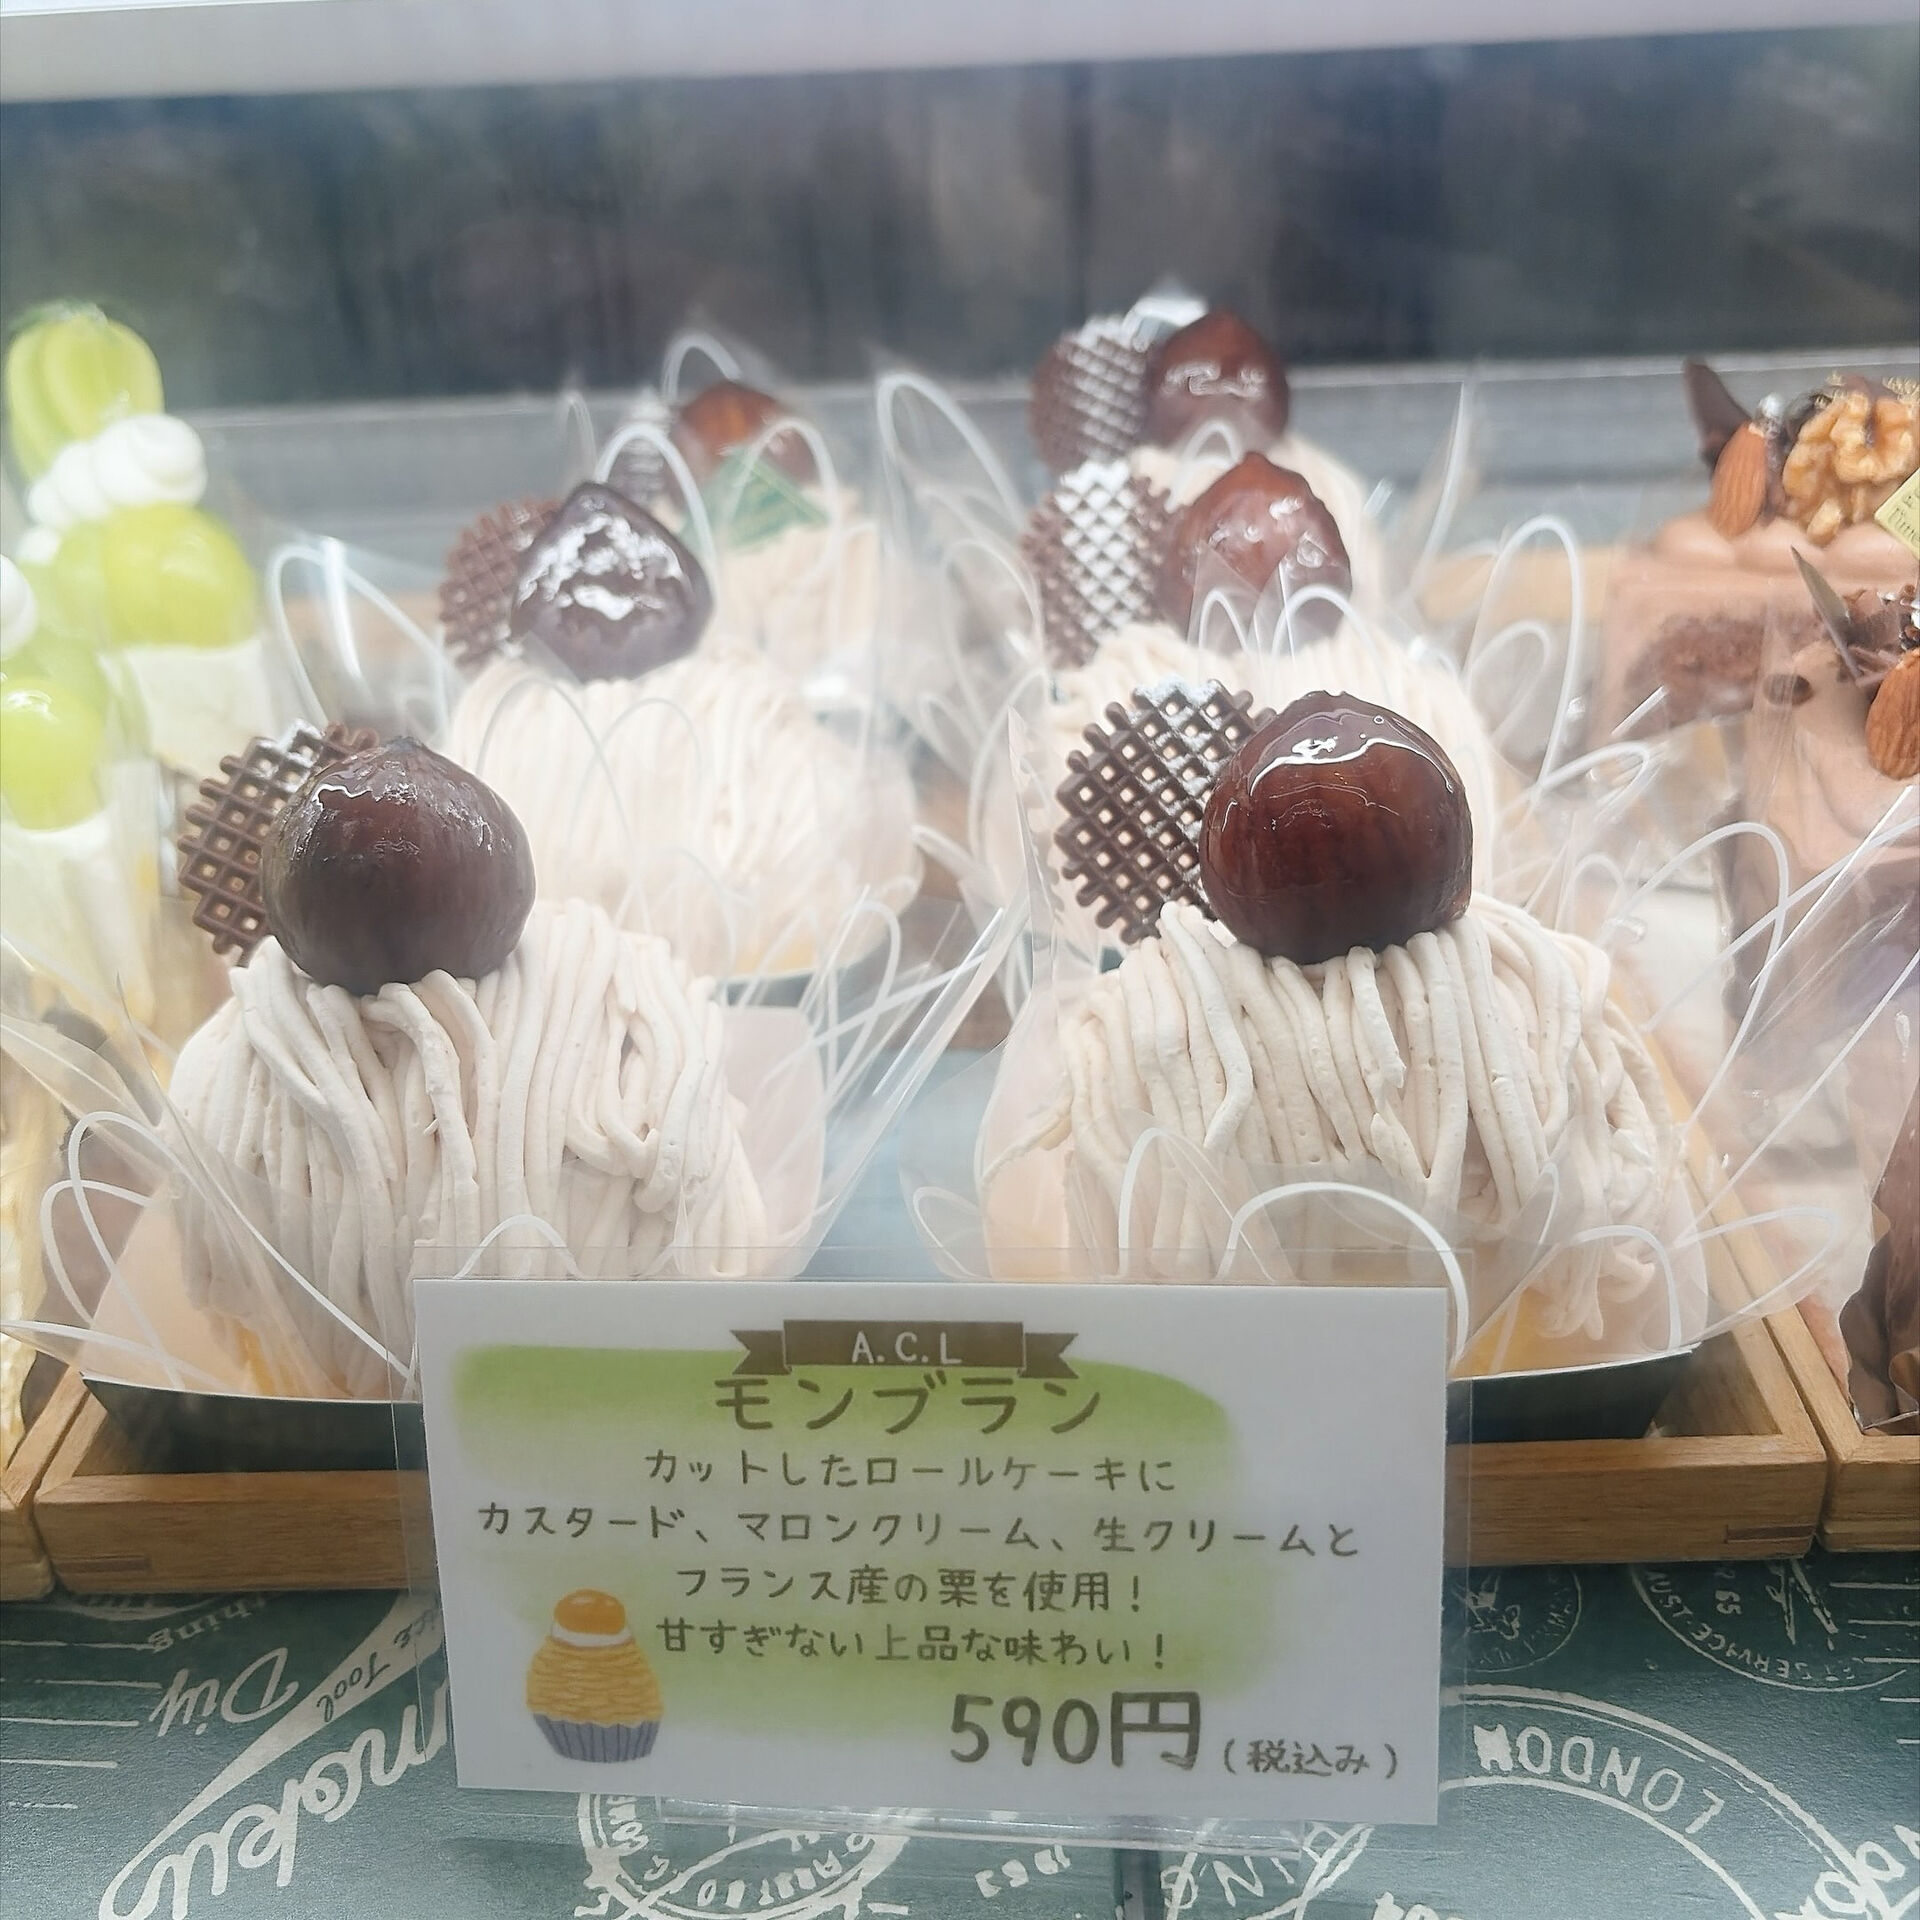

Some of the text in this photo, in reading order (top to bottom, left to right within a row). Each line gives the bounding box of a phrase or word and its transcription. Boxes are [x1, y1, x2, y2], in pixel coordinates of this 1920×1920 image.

[852, 1331, 962, 1365] A.C.L
[715, 1370, 1100, 1434] モンブラン
[645, 1449, 1176, 1492] カットしたロールケーキに
[478, 1502, 1358, 1557] カスタード、マロンクリーム、生クリームと
[677, 1564, 1140, 1612] フランス産の栗を使用！
[656, 1617, 1165, 1669] 甘すぎない上品な味わい！
[950, 1692, 1398, 1780] 590円 （税込み）
